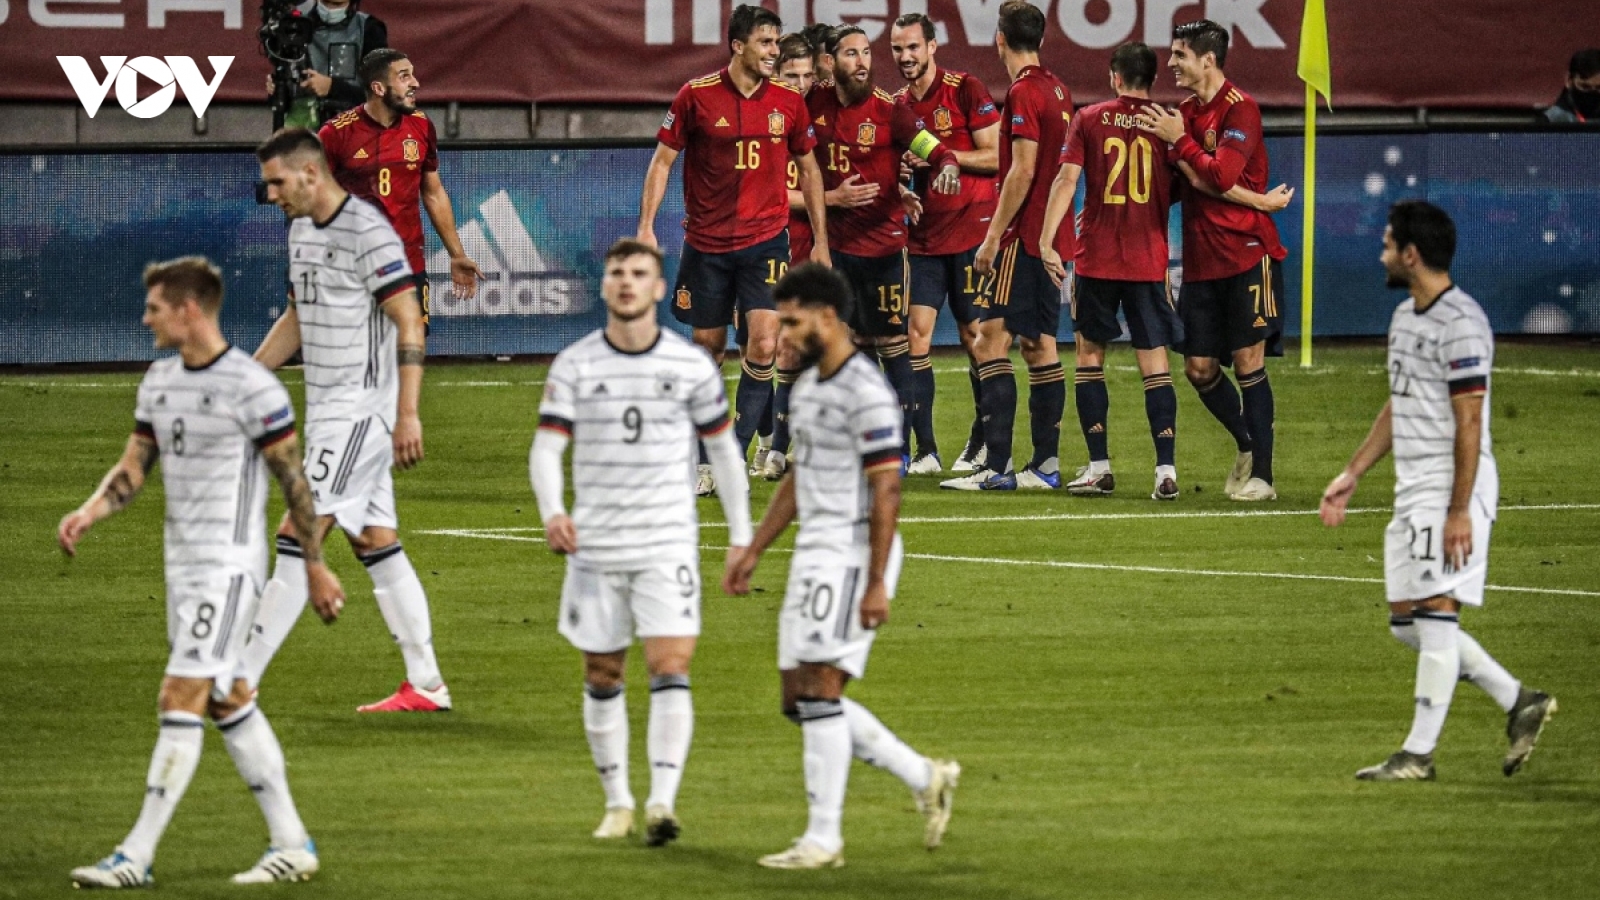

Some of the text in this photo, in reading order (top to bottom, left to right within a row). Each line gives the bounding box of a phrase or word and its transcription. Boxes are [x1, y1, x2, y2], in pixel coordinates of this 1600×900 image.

[735, 141, 760, 169] 16
[827, 143, 851, 173] 15
[1103, 136, 1152, 204] 20
[379, 169, 390, 196] 8
[787, 161, 798, 189] 9
[878, 285, 901, 312] 15
[1248, 284, 1262, 314] 7
[171, 418, 184, 456] 8
[623, 406, 642, 443] 9
[676, 565, 694, 597] 9
[191, 603, 215, 639] 8
